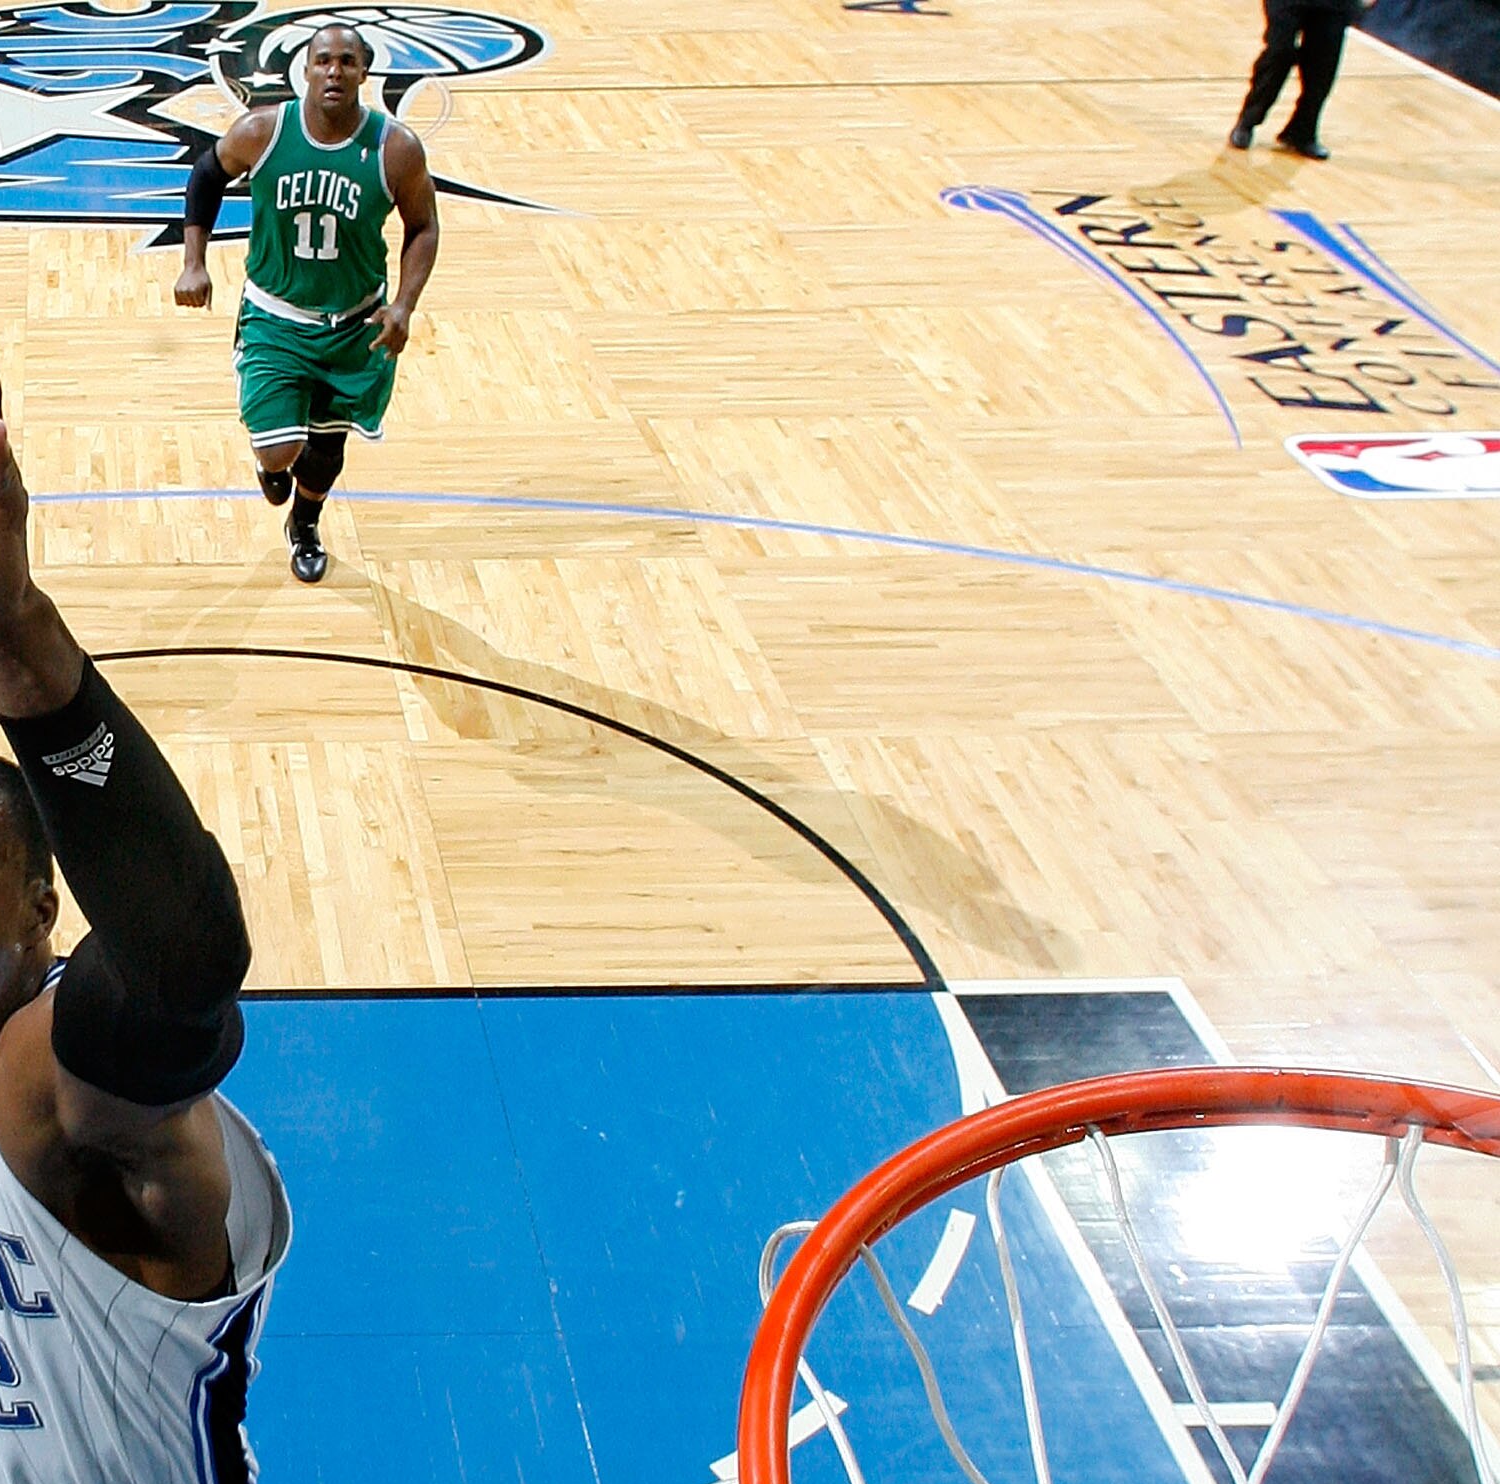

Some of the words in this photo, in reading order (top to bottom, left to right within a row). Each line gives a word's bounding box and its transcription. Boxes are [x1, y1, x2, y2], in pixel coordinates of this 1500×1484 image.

[276, 169, 361, 220] CELTICS
[293, 211, 339, 260] 11
[1031, 189, 1392, 413] EASTERN
[1132, 195, 1457, 416] CONFERENCE
[1252, 239, 1500, 390] FINALS
[52, 732, 114, 777] adidas
